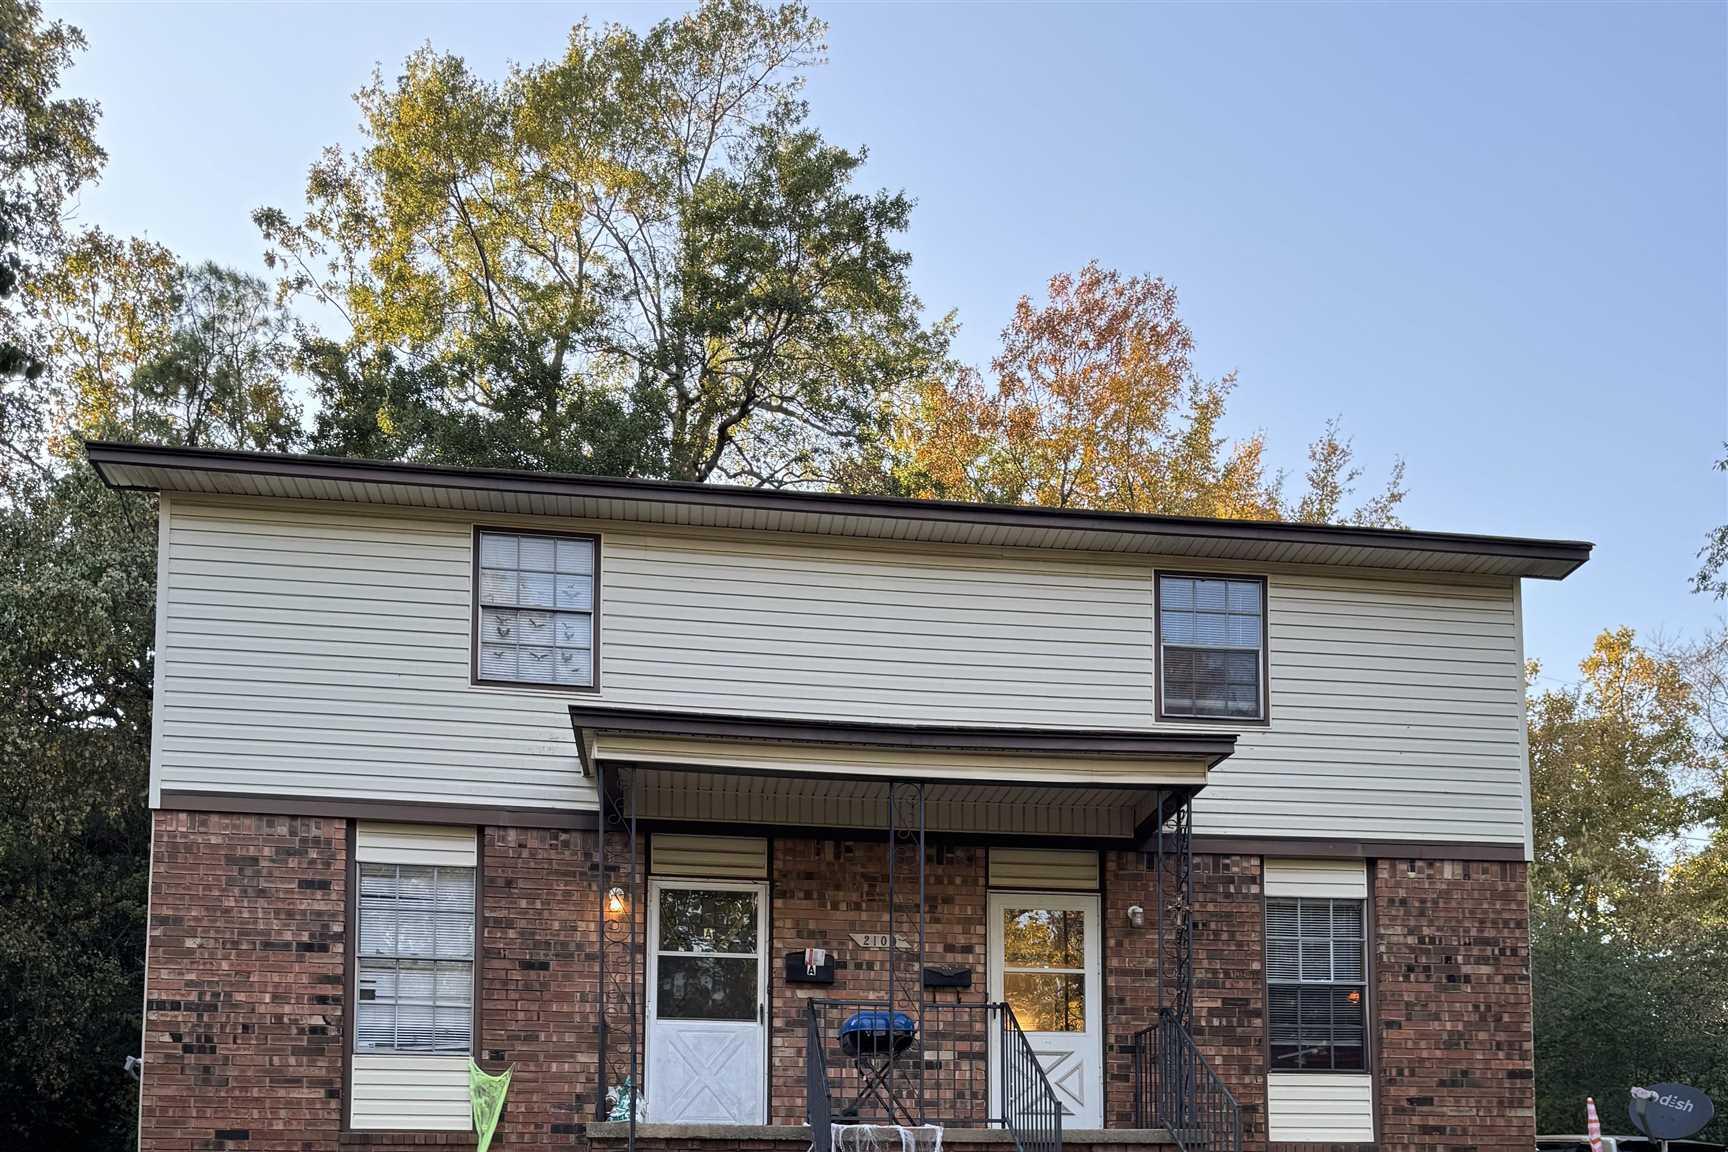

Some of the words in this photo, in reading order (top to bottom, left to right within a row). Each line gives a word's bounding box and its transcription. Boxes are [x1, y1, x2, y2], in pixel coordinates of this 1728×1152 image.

[864, 935, 896, 946] 210
[808, 965, 815, 975] A
[1659, 1094, 1694, 1112] dish
